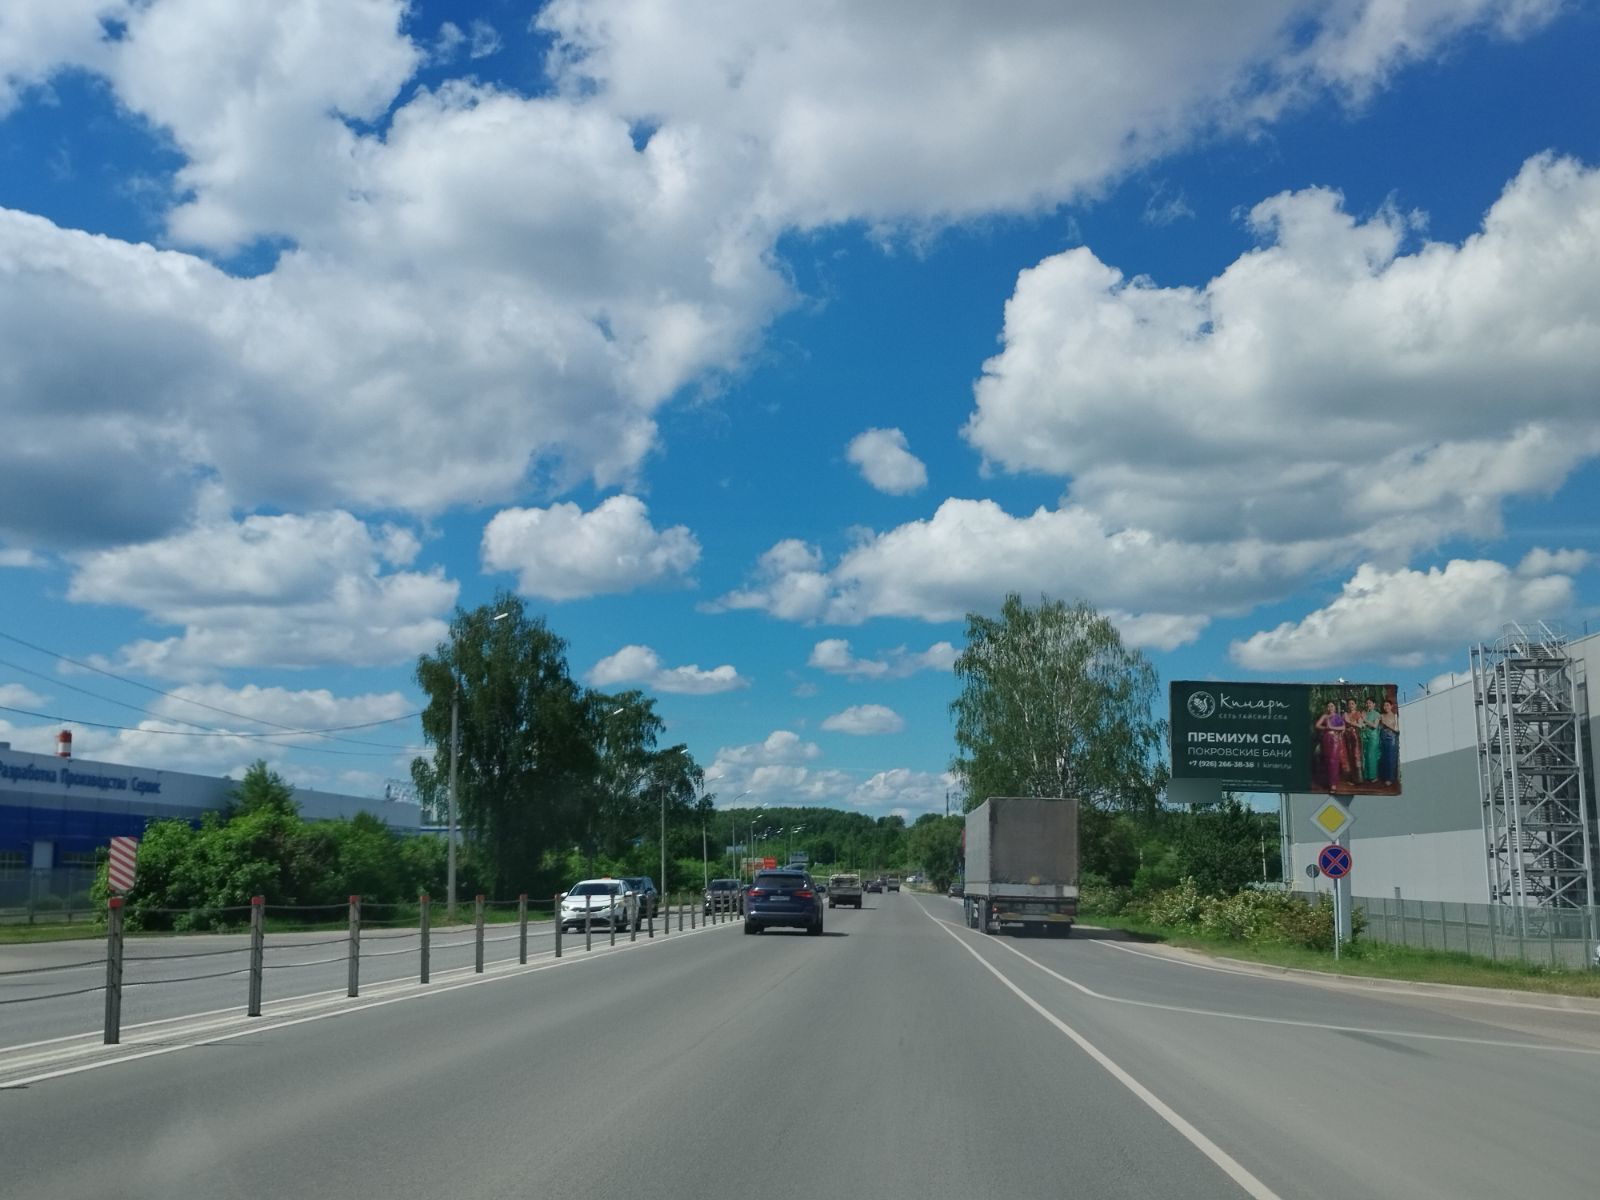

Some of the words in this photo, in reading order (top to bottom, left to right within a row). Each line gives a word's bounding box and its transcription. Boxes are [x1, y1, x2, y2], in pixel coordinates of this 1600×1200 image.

[1220, 692, 1290, 716] Кинари
[1187, 732, 1259, 744] ПРЕМИУМ
[1261, 733, 1292, 745] СПА
[1187, 746, 1260, 757] ПОКРОВСКИЕ
[1262, 748, 1292, 758] БАНИ
